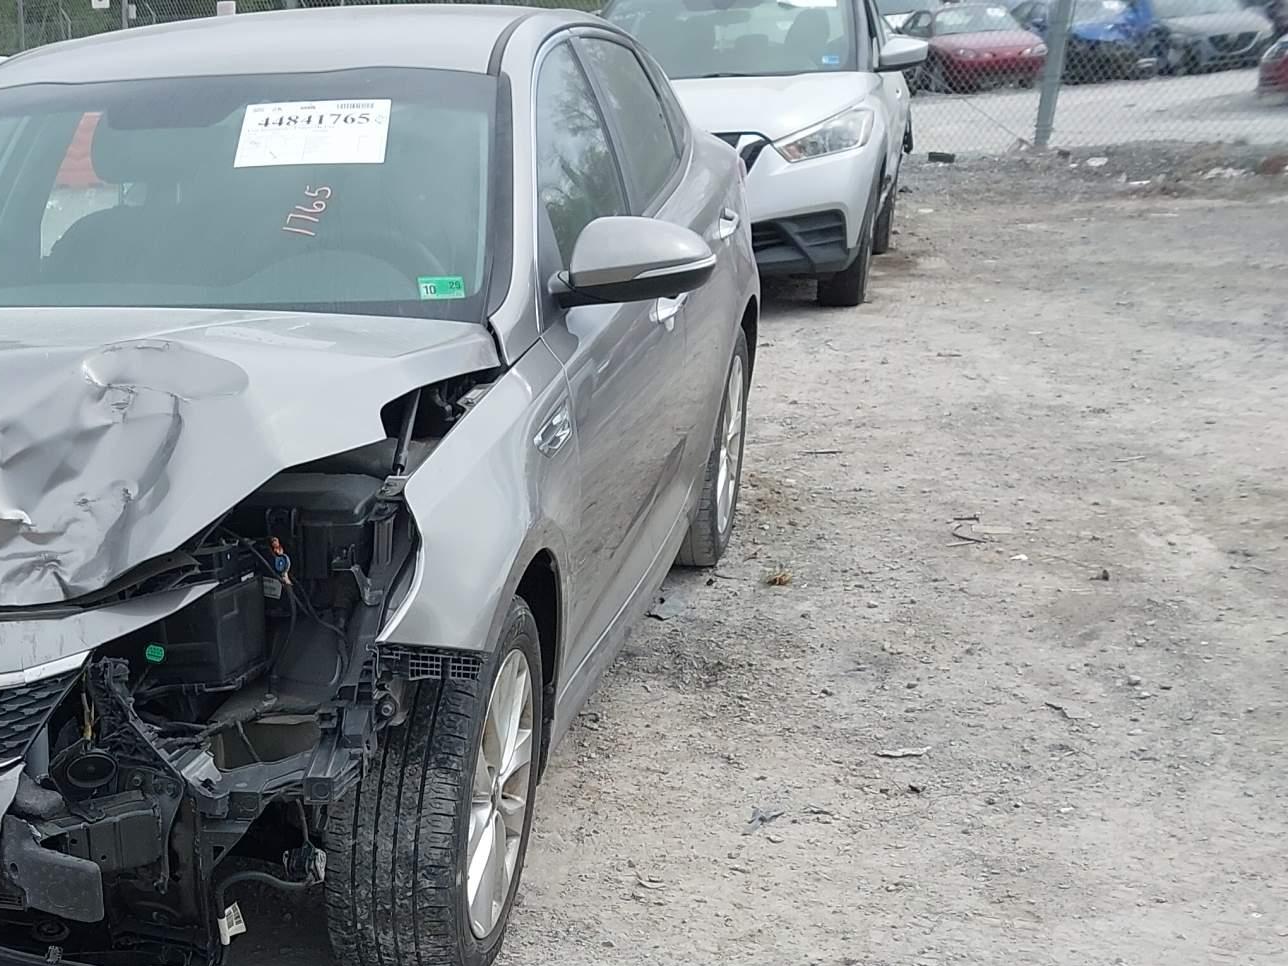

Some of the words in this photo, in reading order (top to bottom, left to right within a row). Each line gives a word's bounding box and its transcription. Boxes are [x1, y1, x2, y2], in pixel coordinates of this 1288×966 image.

[258, 113, 371, 127] 44841765
[282, 185, 332, 236] 1765
[423, 285, 437, 295] 10
